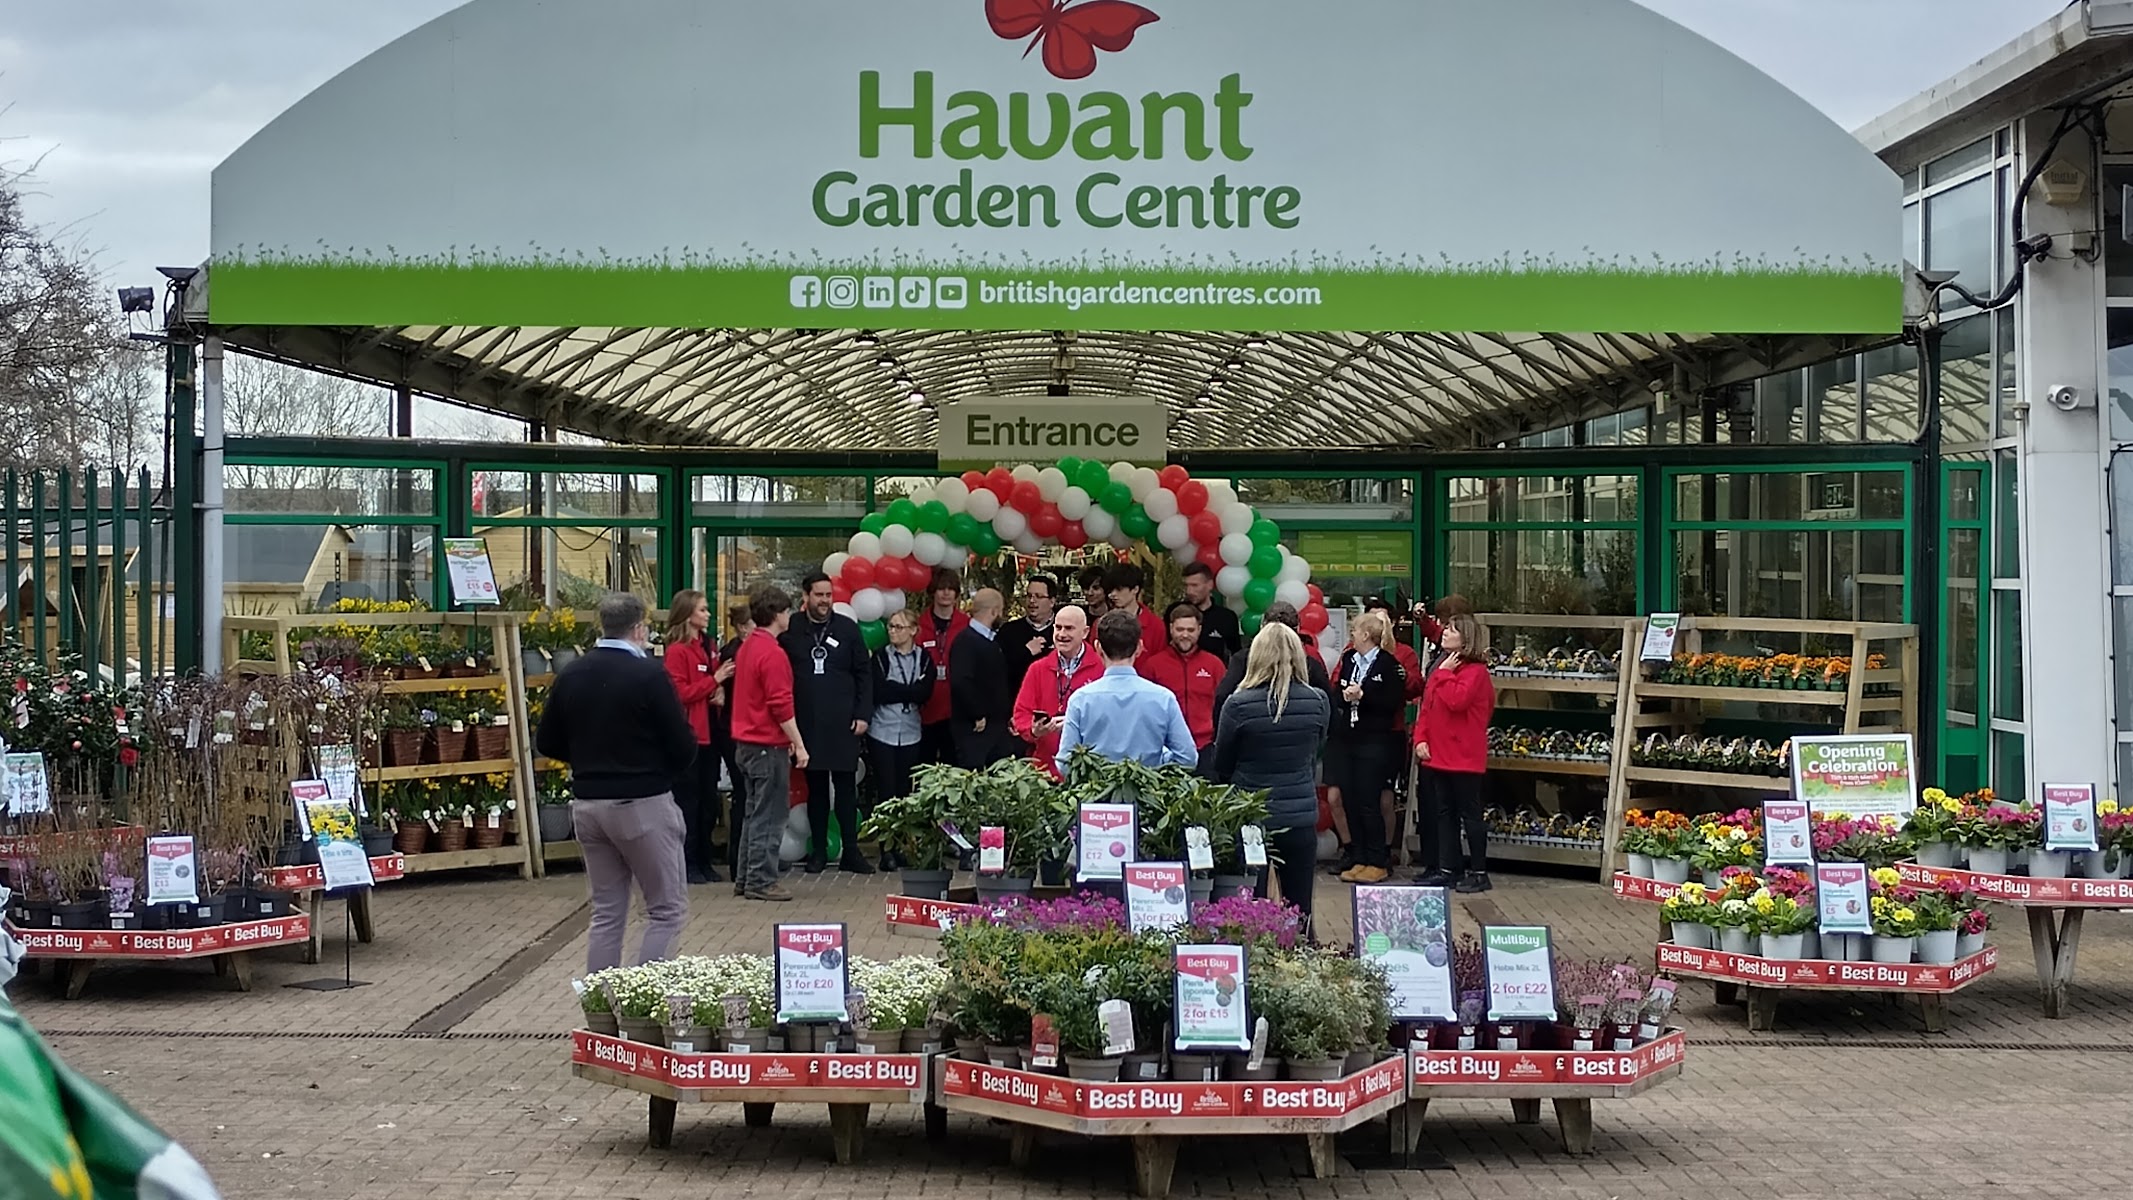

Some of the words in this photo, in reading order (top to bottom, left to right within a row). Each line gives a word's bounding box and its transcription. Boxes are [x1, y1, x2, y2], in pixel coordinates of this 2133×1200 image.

[858, 70, 1254, 161] Havant
[812, 168, 1061, 228] Garden
[1076, 172, 1301, 229] Centre
[979, 280, 1322, 310] britishgardencentres.com
[967, 414, 1139, 446] Entrance
[1819, 744, 1885, 762] Opening
[1808, 758, 1898, 773] Celebration
[2069, 790, 2082, 799] Buy
[1107, 813, 1122, 823] Buy
[1786, 808, 1799, 816] Buy
[172, 845, 186, 853] Buy
[1086, 852, 1102, 860] £12
[1136, 871, 1155, 880] Best
[1157, 871, 1176, 882] Buy
[1826, 870, 1841, 878] Best
[1842, 870, 1856, 879] Buy
[1646, 880, 1651, 891] £
[1654, 884, 1675, 897] Best
[1899, 868, 1920, 881] Best
[1980, 877, 2003, 892] Best
[2004, 879, 2030, 898] Buy
[2071, 882, 2078, 892] £
[2084, 883, 2116, 897] Best
[922, 904, 927, 915] £
[1134, 913, 1140, 921] 3
[1143, 913, 1157, 921] for
[1160, 913, 1178, 921] £20
[224, 929, 230, 939] £
[234, 927, 259, 941] Best
[261, 925, 283, 939] Buy
[789, 933, 811, 942] Best
[812, 933, 833, 944] Buy
[1490, 934, 1540, 947] MultiBuy
[22, 934, 52, 947] Best
[55, 934, 83, 951] Buy
[122, 935, 128, 945] £
[134, 936, 164, 949] Best
[167, 937, 193, 952] Buy
[1187, 958, 1208, 967] Best
[1209, 958, 1229, 970] Buy
[1660, 948, 1682, 962] Best
[1683, 952, 1702, 969] Buy
[1729, 957, 1734, 967] £
[1737, 959, 1760, 975] Best
[1761, 961, 1786, 981] Buy
[1828, 965, 1836, 975] £
[1841, 965, 1874, 981] Best
[1880, 967, 1907, 985] Buy
[785, 979, 792, 989] 3
[795, 979, 810, 989] for
[814, 979, 833, 989] £20
[1492, 983, 1500, 994] 2
[1503, 983, 1521, 994] for
[1524, 983, 1547, 994] £22
[1183, 1009, 1190, 1018] 2
[1192, 1009, 1206, 1018] for
[1210, 1009, 1228, 1018] £15
[1654, 1045, 1666, 1063] Best
[1666, 1041, 1676, 1062] Buy
[587, 1039, 592, 1050] £
[595, 1040, 616, 1060] Best
[616, 1045, 636, 1071] Buy
[663, 1056, 668, 1068] £
[671, 1058, 705, 1078] Best
[709, 1060, 751, 1084] Buy
[1414, 1056, 1458, 1075] Best
[1461, 1056, 1500, 1080] Buy
[1556, 1057, 1564, 1070] £
[1573, 1057, 1616, 1075] Best
[1620, 1057, 1638, 1078] Buy
[809, 1060, 818, 1073] £
[827, 1060, 872, 1079] Best
[876, 1060, 917, 1086] Buy
[1365, 1073, 1379, 1095] Best
[1379, 1069, 1391, 1092] Buy
[971, 1069, 977, 1083] £
[982, 1071, 1010, 1094] Best
[1012, 1076, 1038, 1105] Buy
[1075, 1088, 1082, 1101] £
[1089, 1089, 1136, 1109] Best
[1140, 1089, 1182, 1114] Buy
[1243, 1088, 1253, 1102] £
[1263, 1088, 1308, 1108] Best
[1313, 1088, 1346, 1113] Buy
